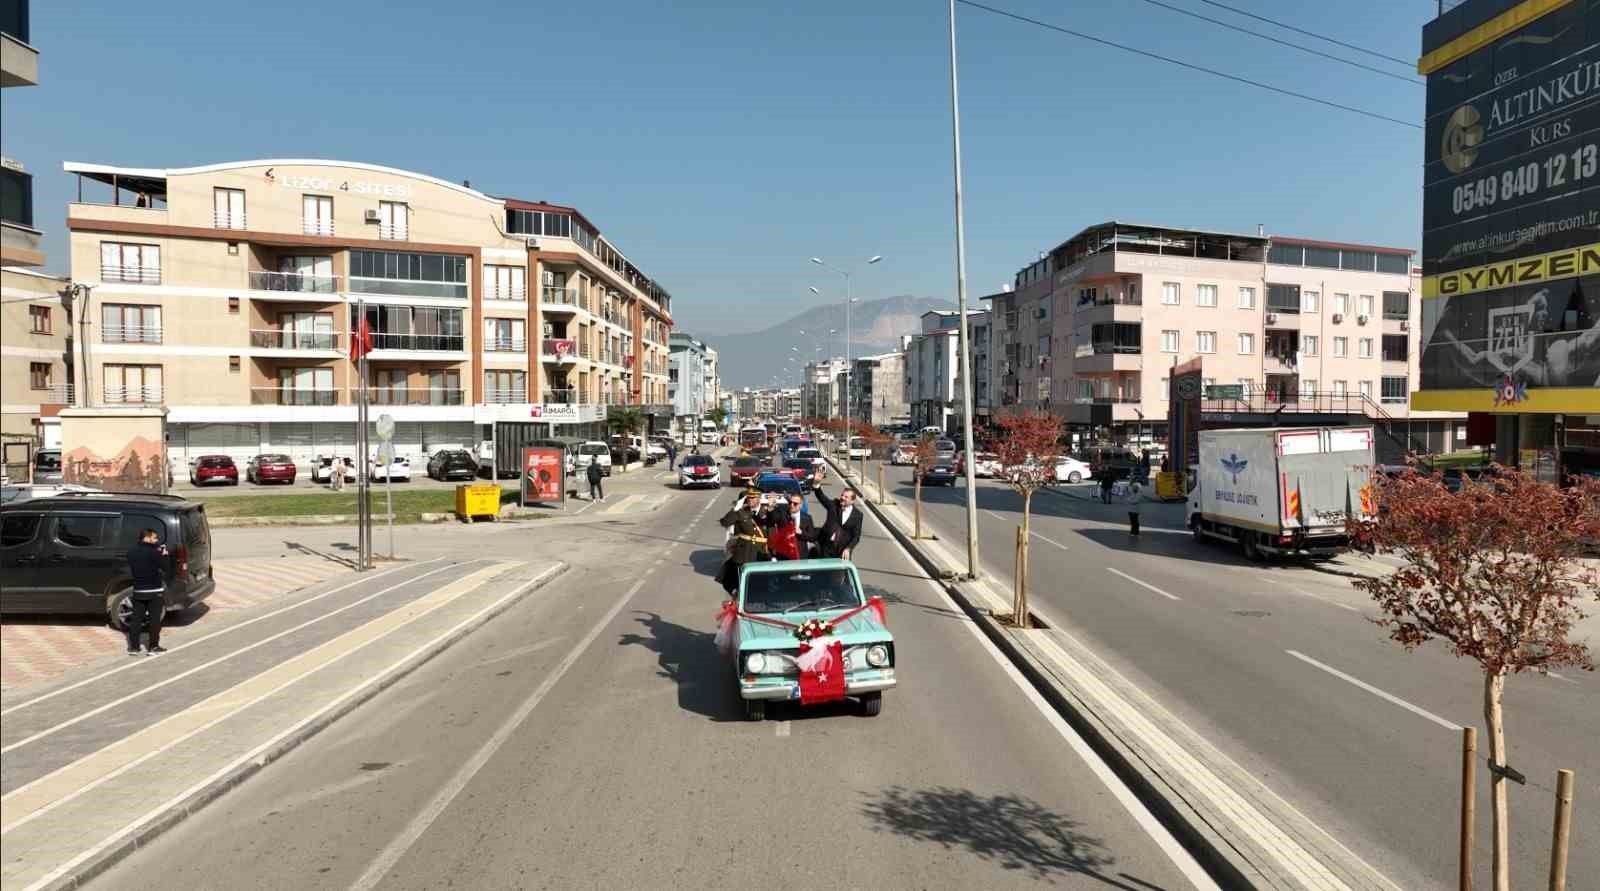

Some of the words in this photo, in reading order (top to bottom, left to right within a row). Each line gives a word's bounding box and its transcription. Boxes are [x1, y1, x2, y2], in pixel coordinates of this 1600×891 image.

[1529, 118, 1572, 147] KURS
[339, 180, 349, 192] 4
[1452, 175, 1497, 215] 0549
[1501, 162, 1539, 201] 840
[1543, 152, 1567, 188] 12
[1571, 143, 1598, 180] 13
[1439, 248, 1600, 295] GYMZEN
[1495, 326, 1524, 353] ZEN
